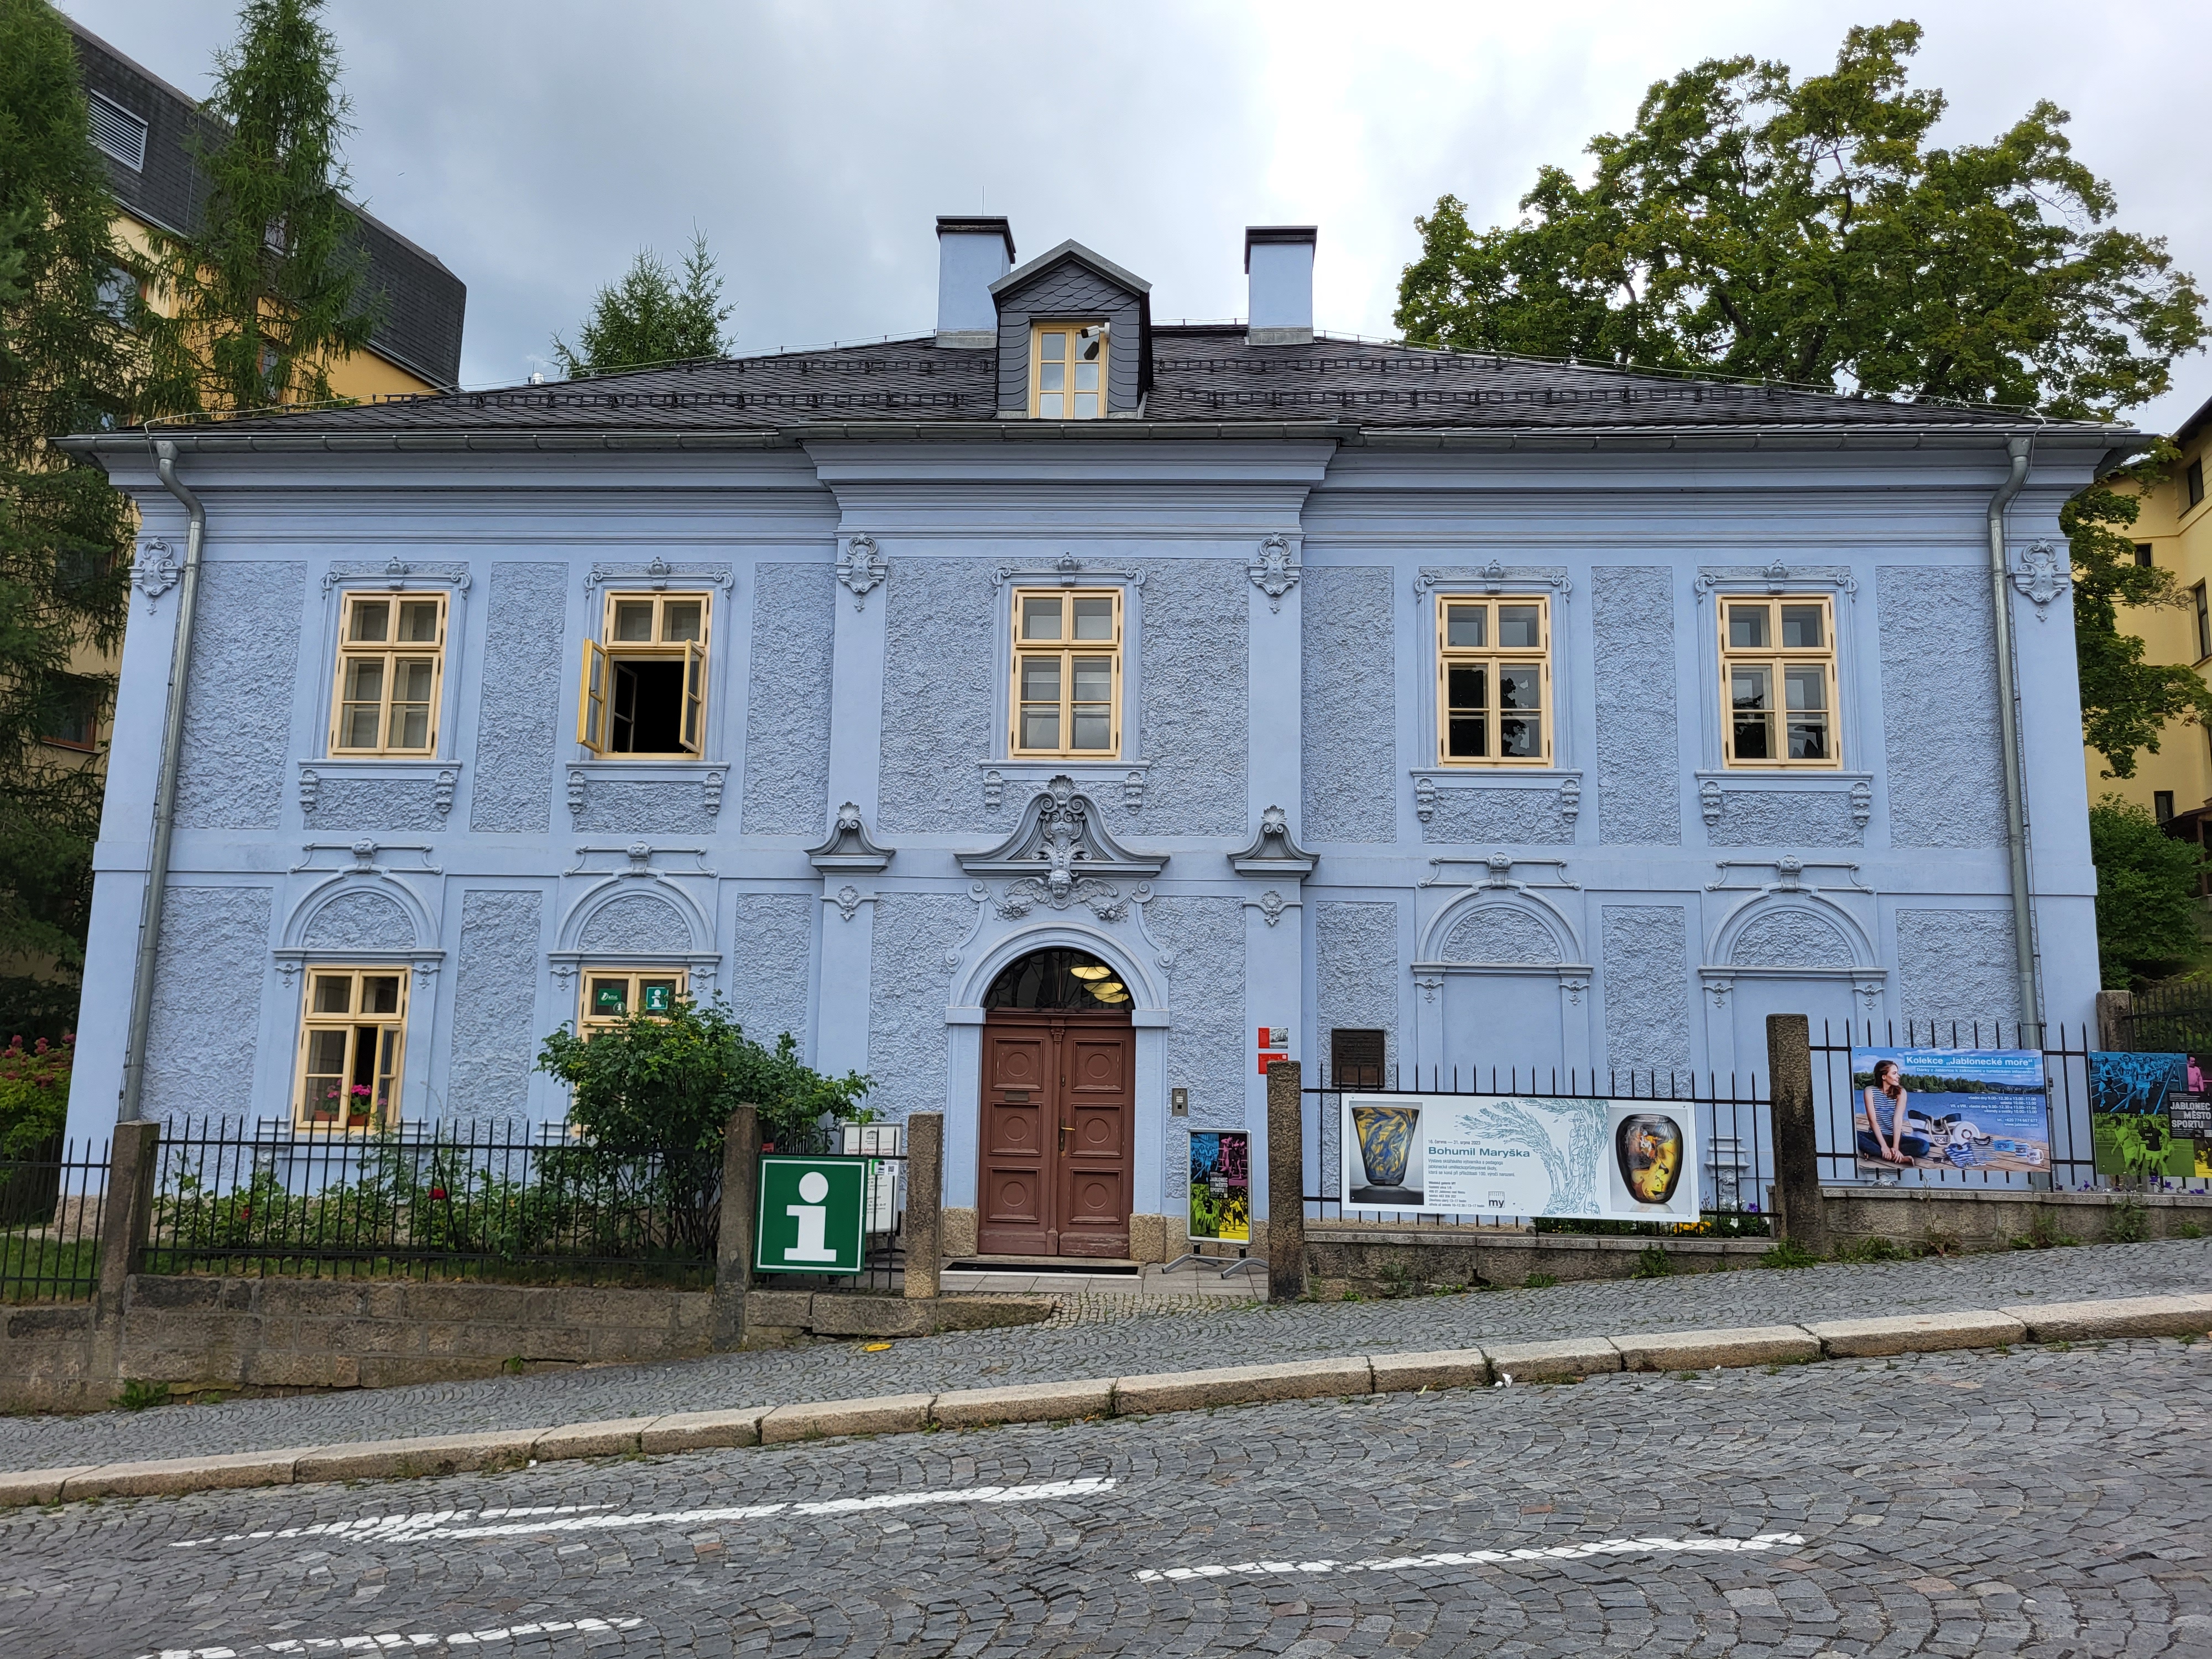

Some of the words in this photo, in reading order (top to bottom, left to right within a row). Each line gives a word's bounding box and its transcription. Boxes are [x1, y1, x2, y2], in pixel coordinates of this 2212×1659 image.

[1906, 1056, 1944, 1065] Kolekce
[2170, 1102, 2211, 1110] JABLONEC
[2183, 1110, 2211, 1119] MĚSTO
[2171, 1120, 2204, 1128] SPORTU
[1428, 1146, 1475, 1156] Bohumil
[1479, 1148, 1530, 1158] Maryška
[1489, 1199, 1504, 1208] my
